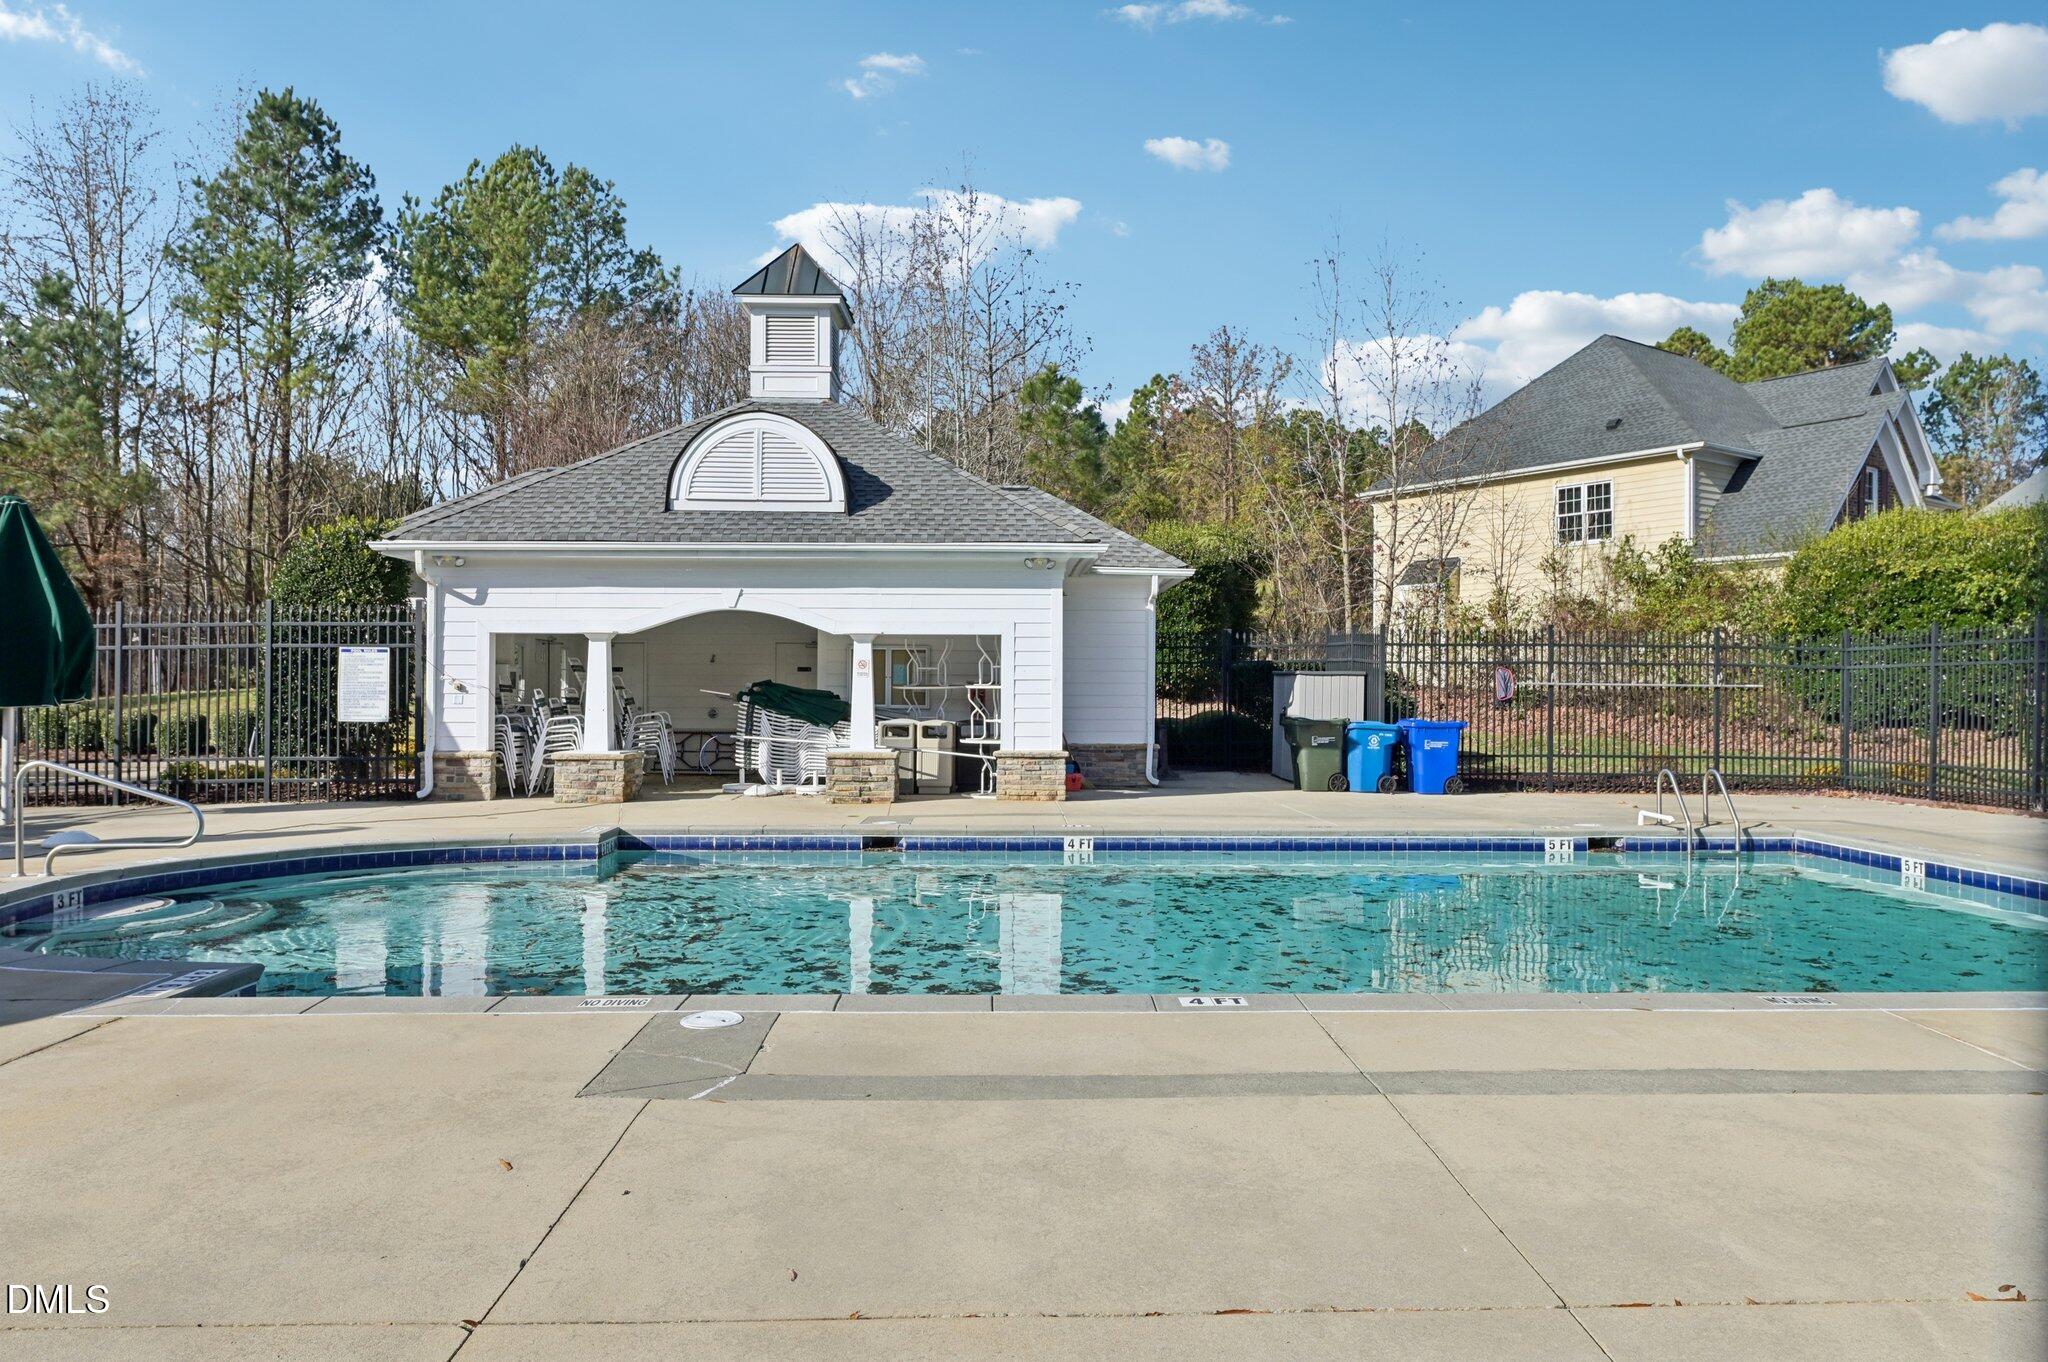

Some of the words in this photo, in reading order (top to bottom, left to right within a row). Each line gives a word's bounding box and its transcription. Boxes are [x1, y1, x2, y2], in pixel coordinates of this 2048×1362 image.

[1067, 838, 1075, 849] 4
[1079, 838, 1093, 849] FT
[1549, 839, 1556, 850] 5
[1560, 839, 1572, 850] FT
[1904, 860, 1910, 872] 5
[1913, 861, 1924, 875] FT
[57, 894, 65, 909] 3
[69, 890, 82, 907] FT
[1189, 997, 1205, 1005] 4
[1213, 997, 1242, 1005] FT
